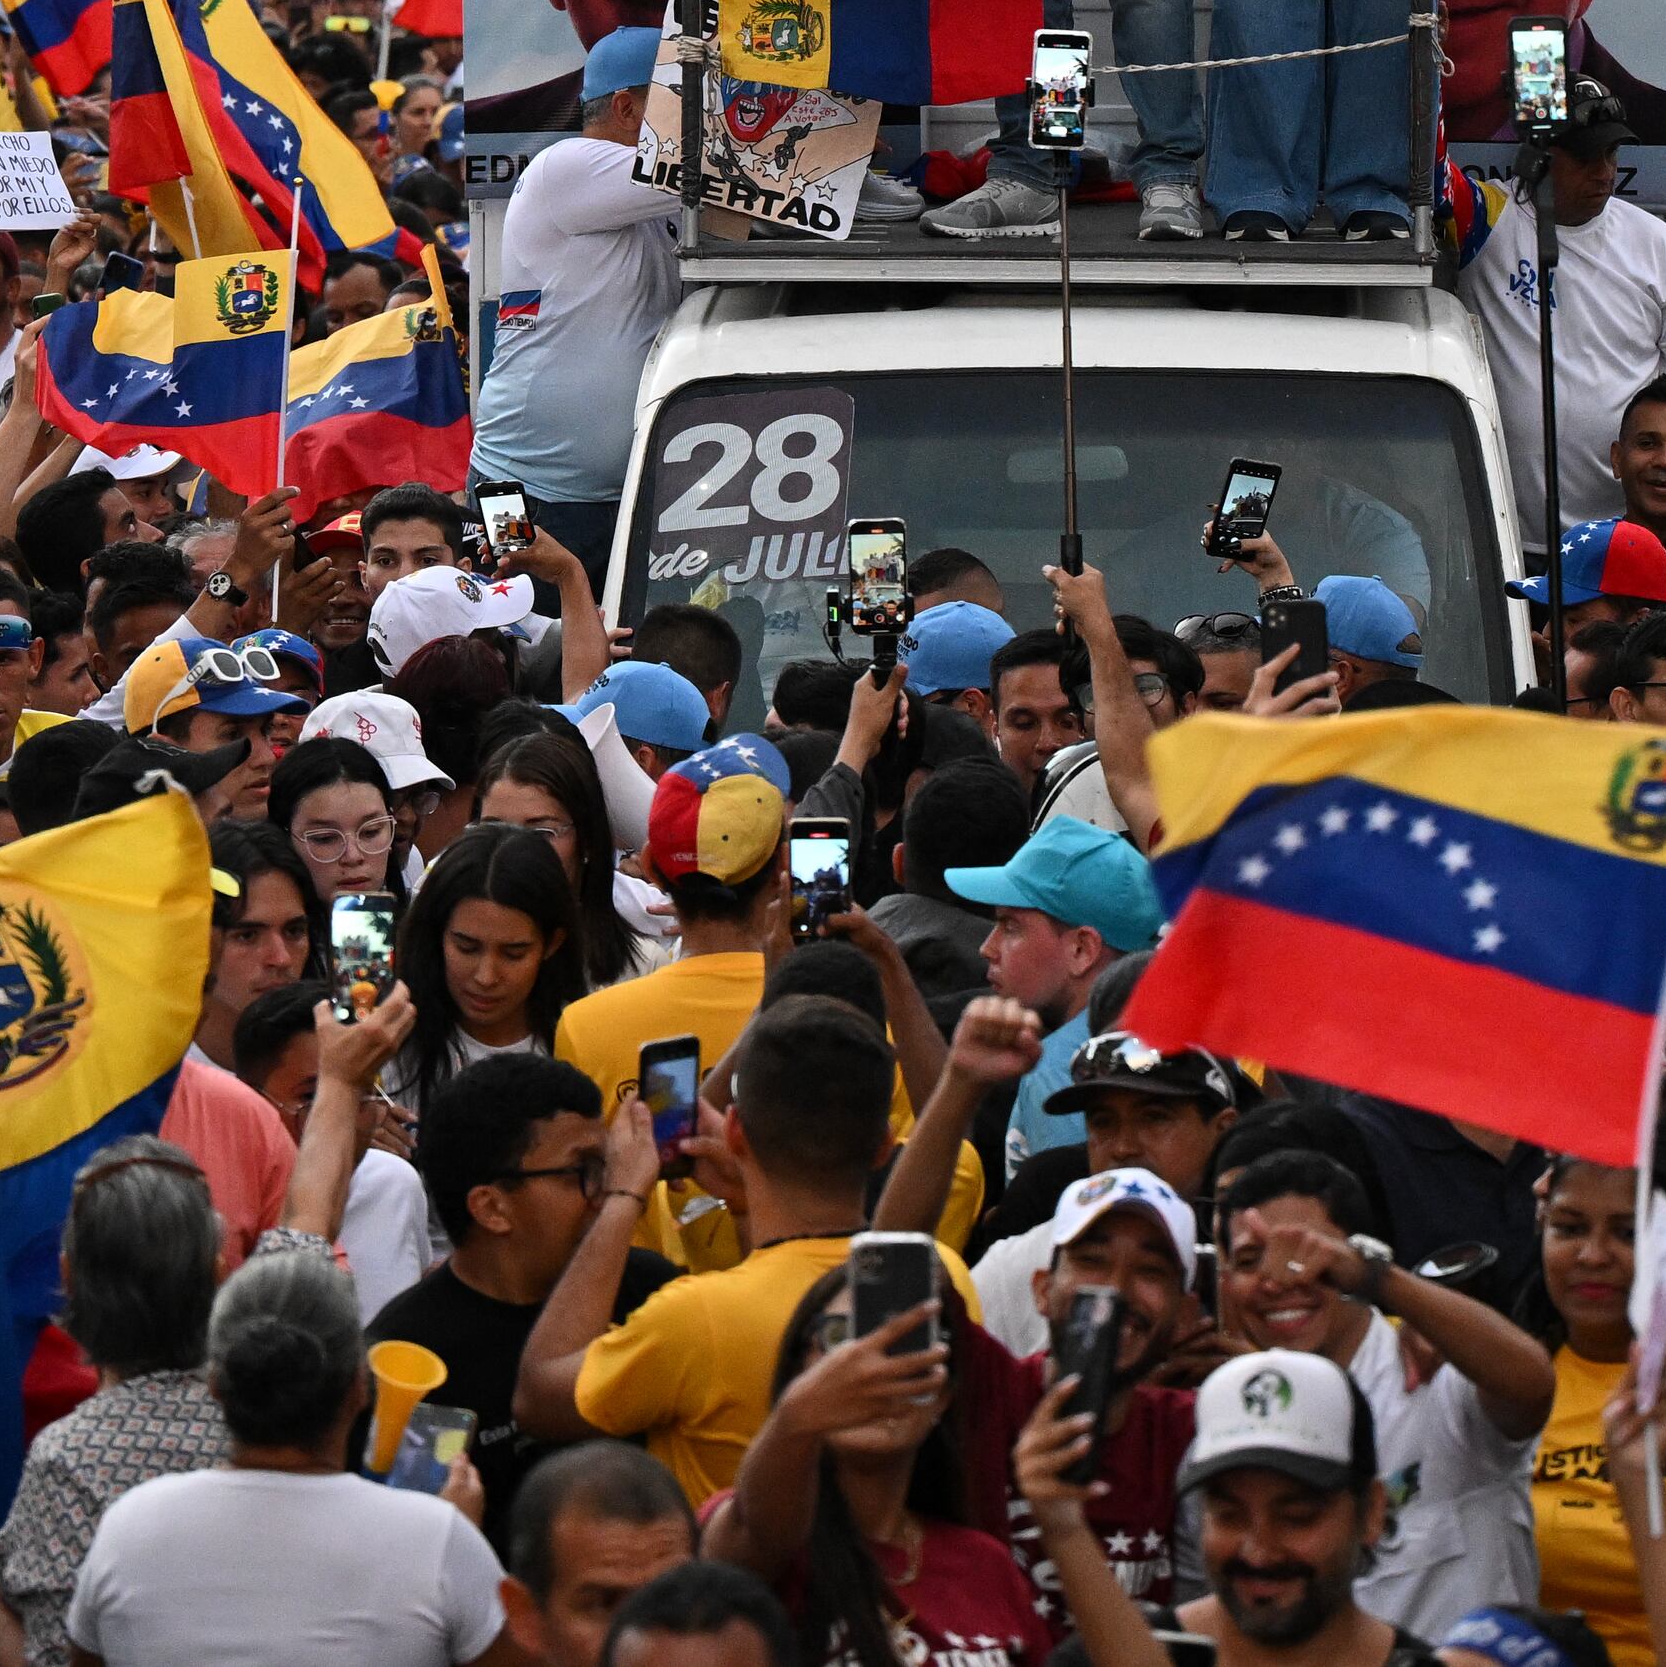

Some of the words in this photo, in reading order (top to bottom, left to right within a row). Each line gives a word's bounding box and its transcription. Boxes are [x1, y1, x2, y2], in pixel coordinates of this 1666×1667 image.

[784, 115, 792, 123] A
[10, 155, 56, 175] MIEDO
[37, 176, 49, 195] Y
[23, 196, 71, 215] ELLOS
[657, 413, 845, 533] 28
[648, 542, 709, 580] de
